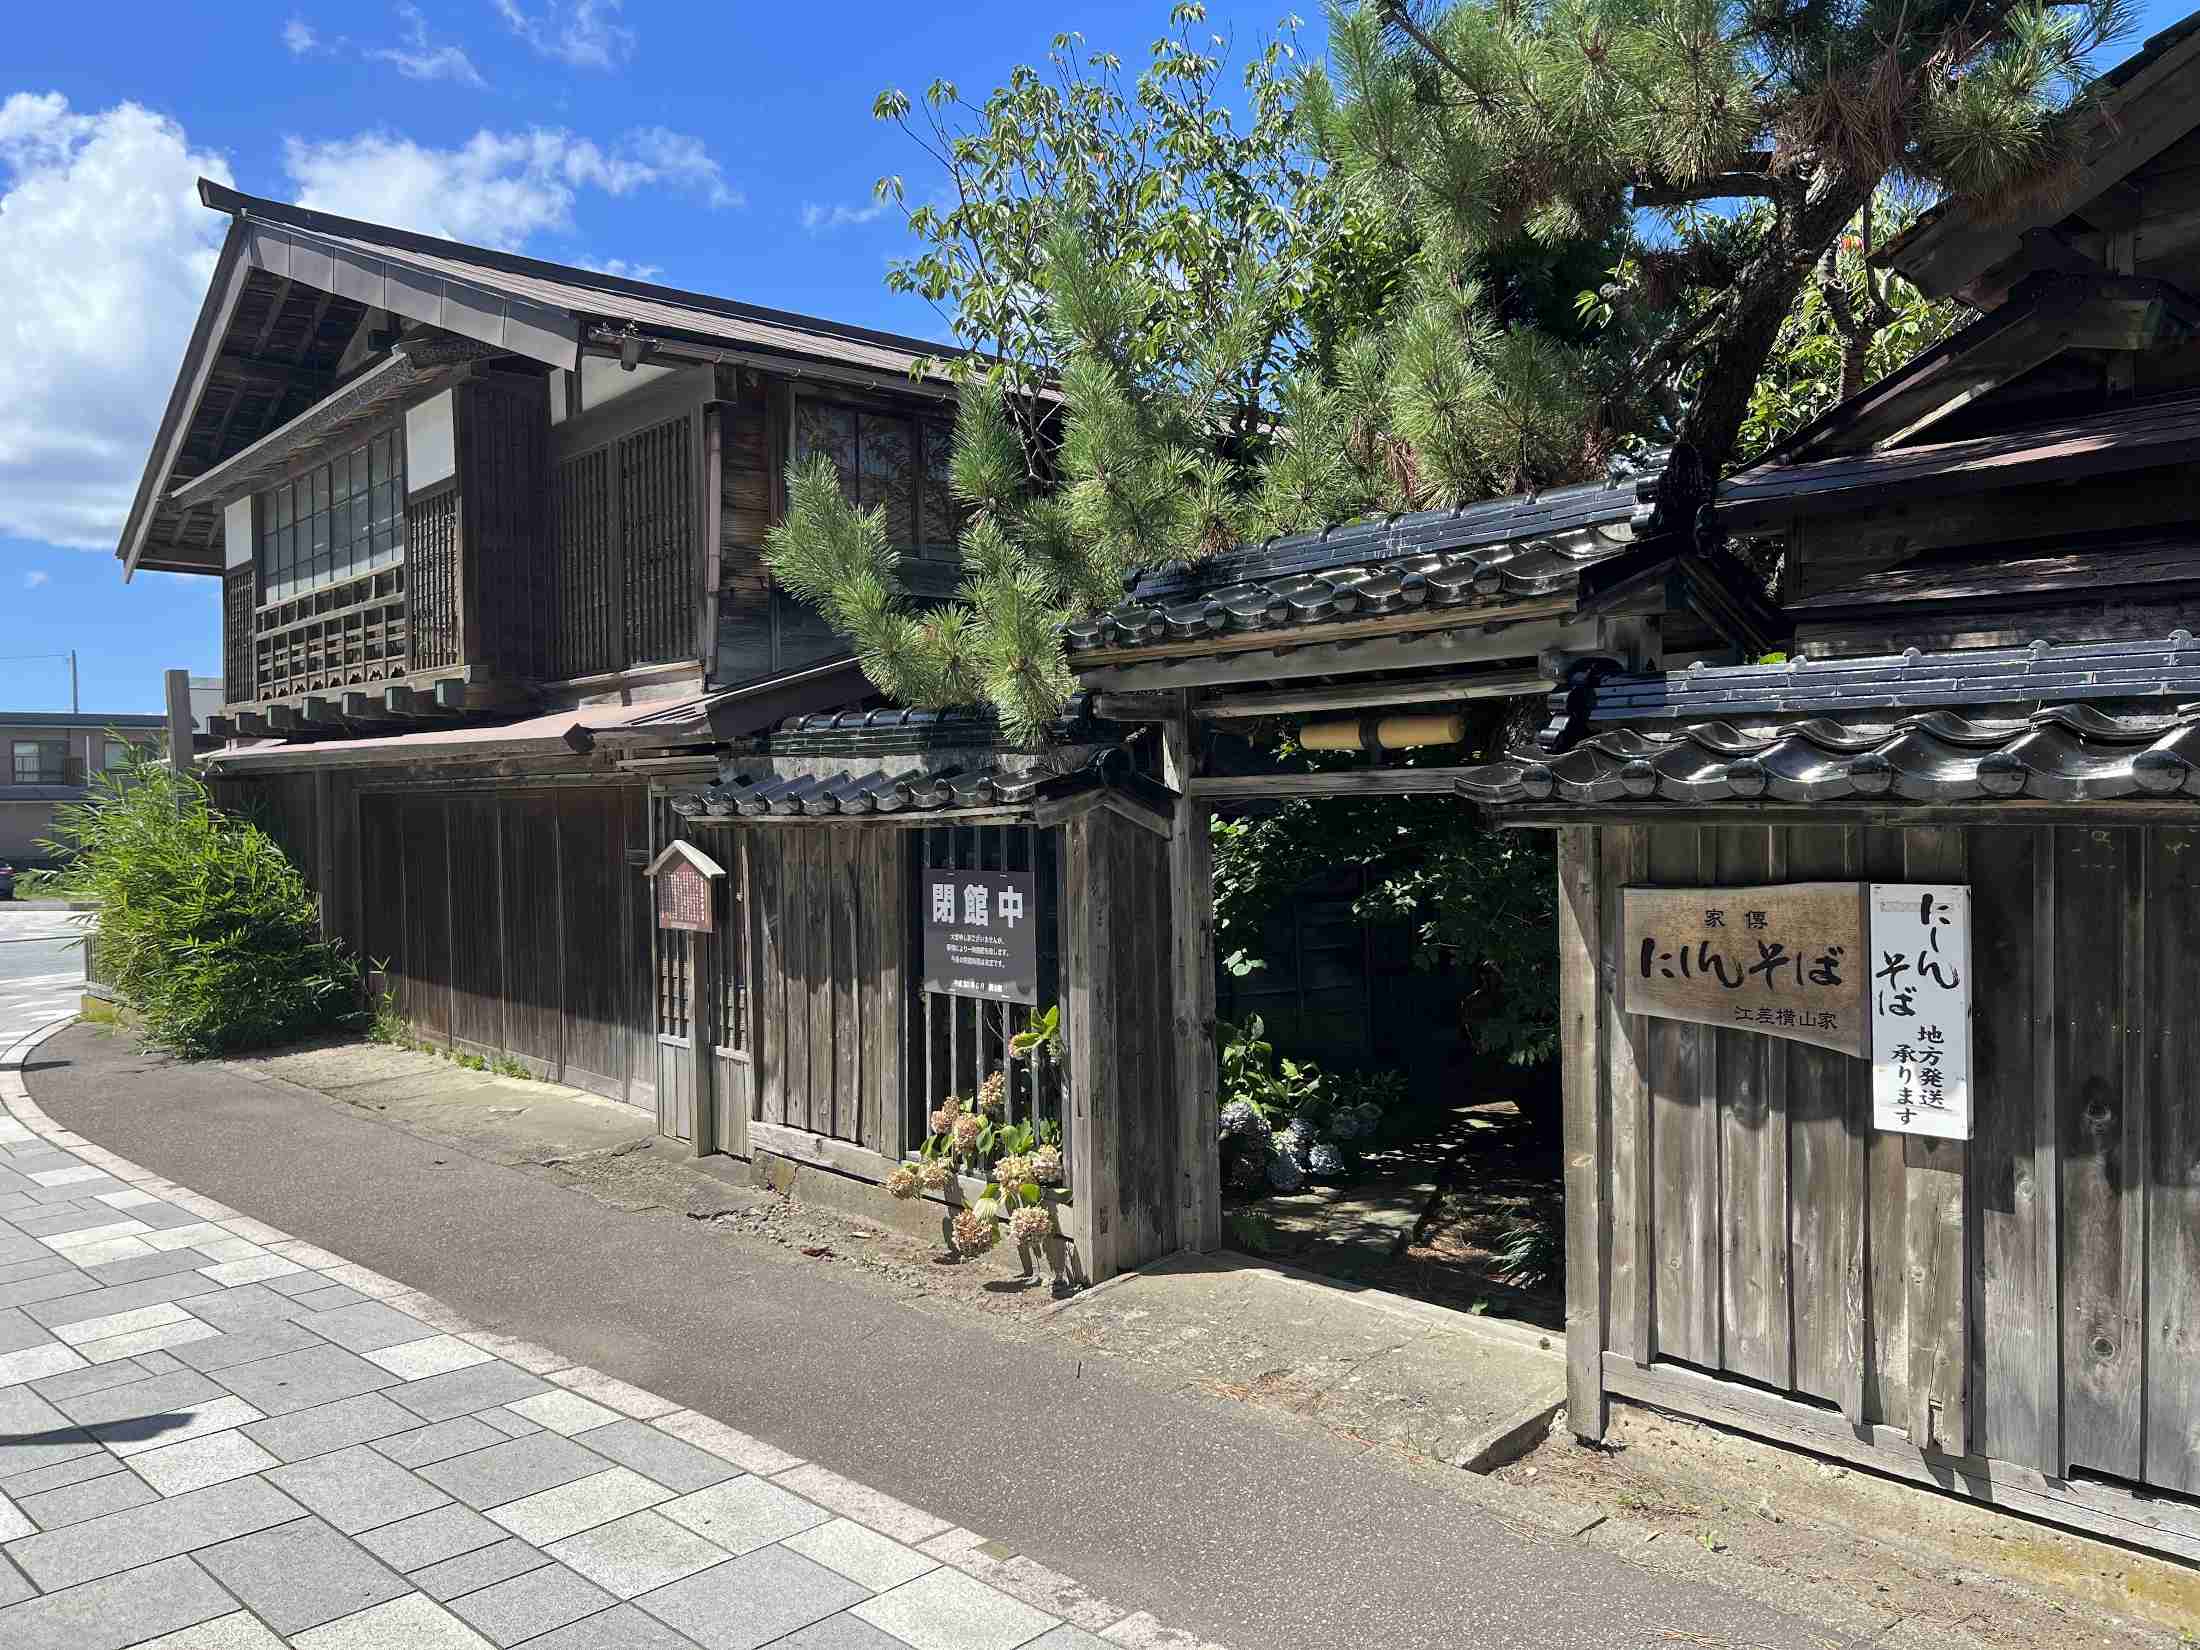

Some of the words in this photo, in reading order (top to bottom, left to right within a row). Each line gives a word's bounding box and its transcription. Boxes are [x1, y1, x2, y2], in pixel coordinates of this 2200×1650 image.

[932, 883, 1024, 928] 閉館中
[1917, 892, 1961, 990] にしん
[1640, 937, 1845, 991] にしんそば
[1875, 950, 1918, 1017] そば
[1889, 1043, 1918, 1126] 承ります
[1917, 1024, 1946, 1110] 地方発送
